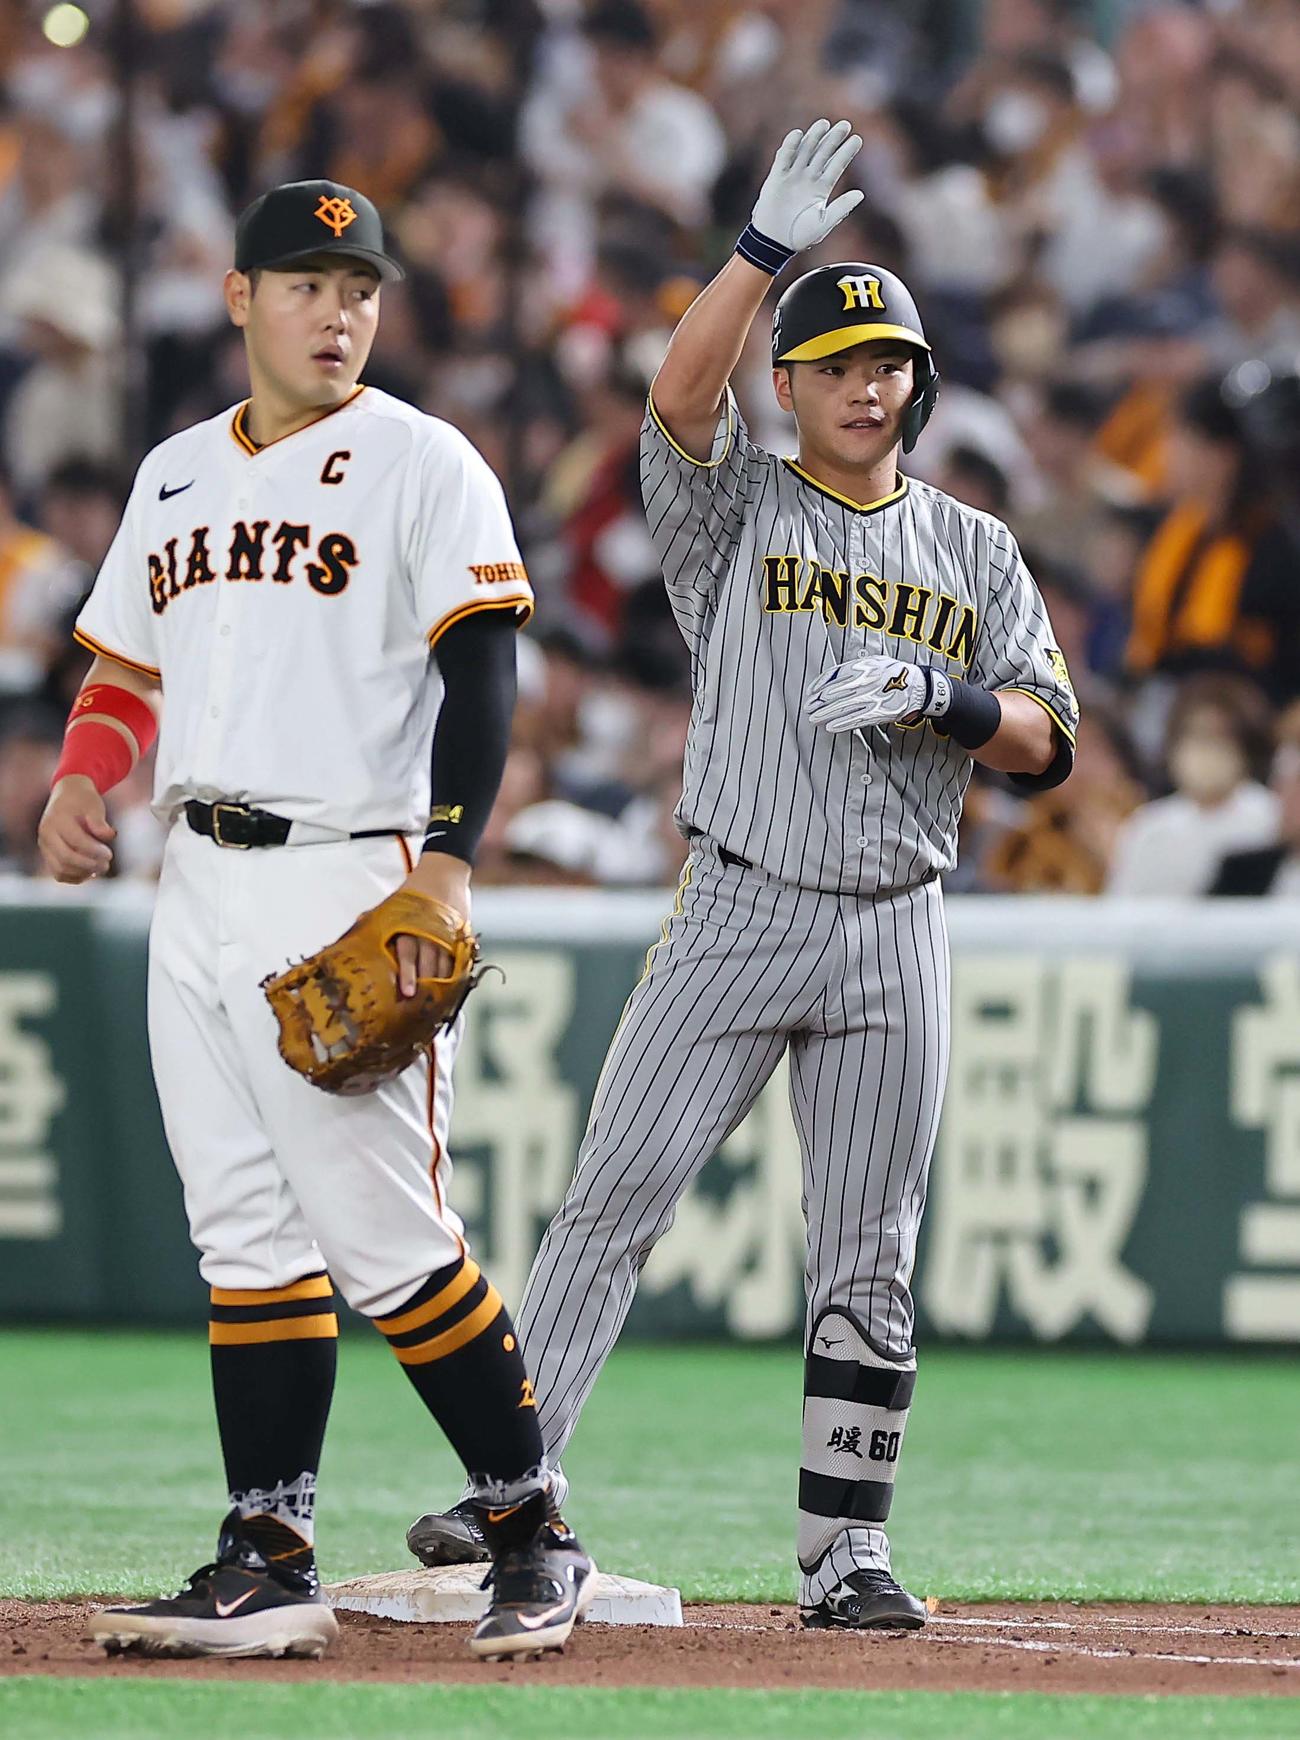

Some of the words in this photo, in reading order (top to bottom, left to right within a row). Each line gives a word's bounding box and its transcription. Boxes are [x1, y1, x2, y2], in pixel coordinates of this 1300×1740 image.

[319, 449, 352, 485] C
[147, 519, 360, 616] GIANTS
[763, 555, 978, 670] HANSHIN
[827, 1426, 863, 1459] 暖
[868, 1429, 901, 1462] 60
